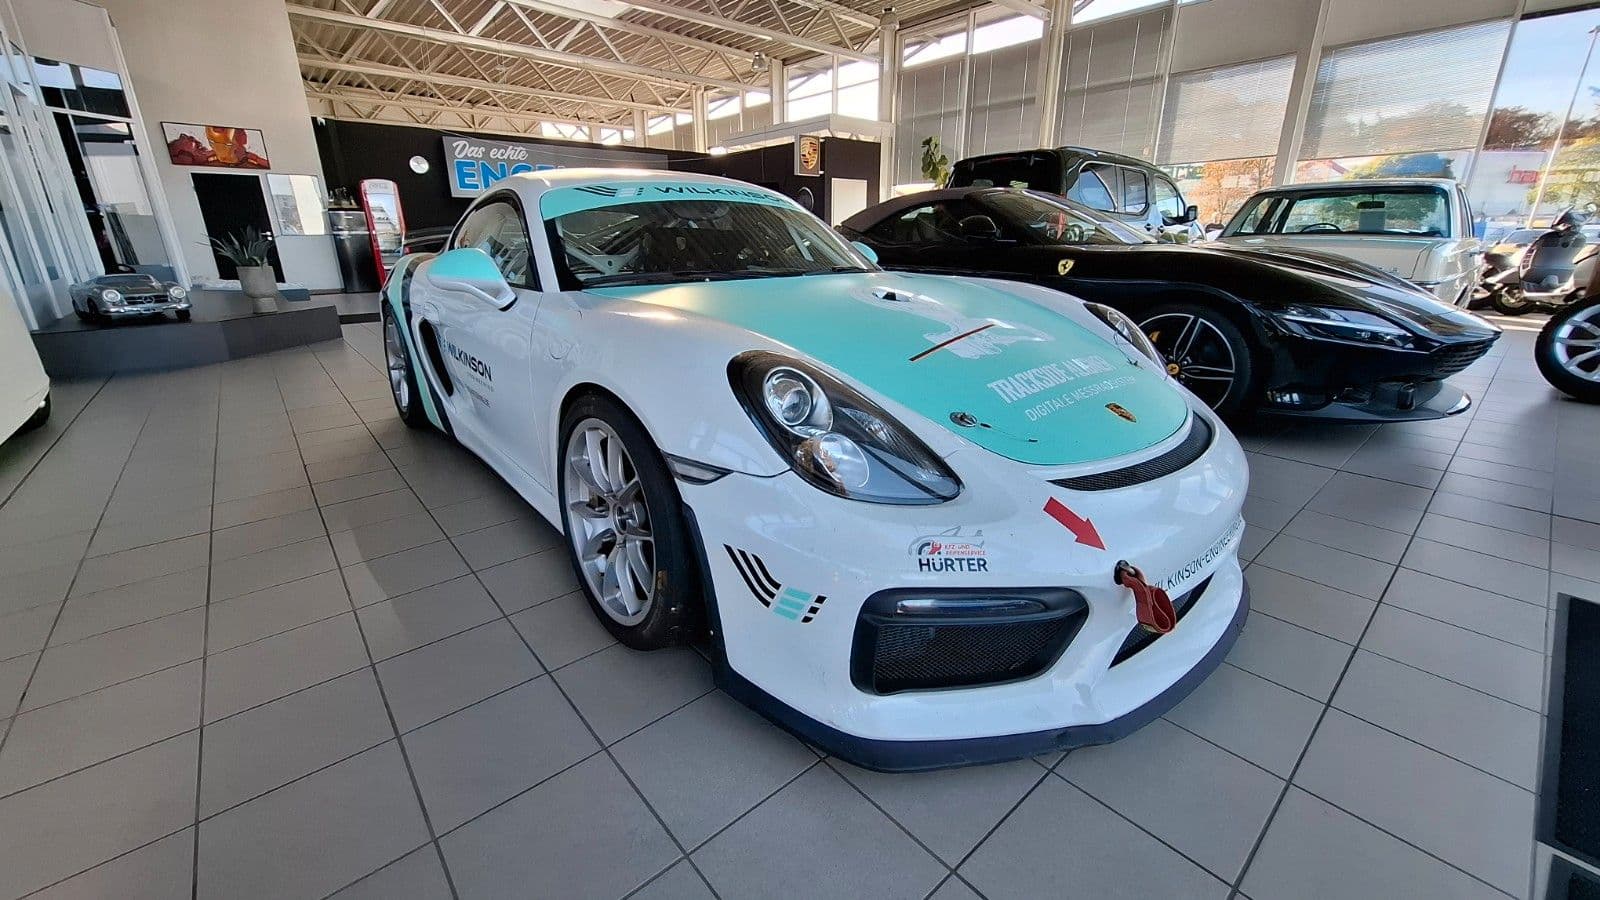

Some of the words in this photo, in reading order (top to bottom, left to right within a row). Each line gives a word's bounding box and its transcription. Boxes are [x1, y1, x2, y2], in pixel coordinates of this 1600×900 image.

[453, 141, 484, 158] Das
[489, 145, 528, 161] echte
[987, 363, 1074, 403] TRACKSIDE
[1025, 390, 1075, 422] DIGITALE
[918, 558, 988, 572] HÜRTER
